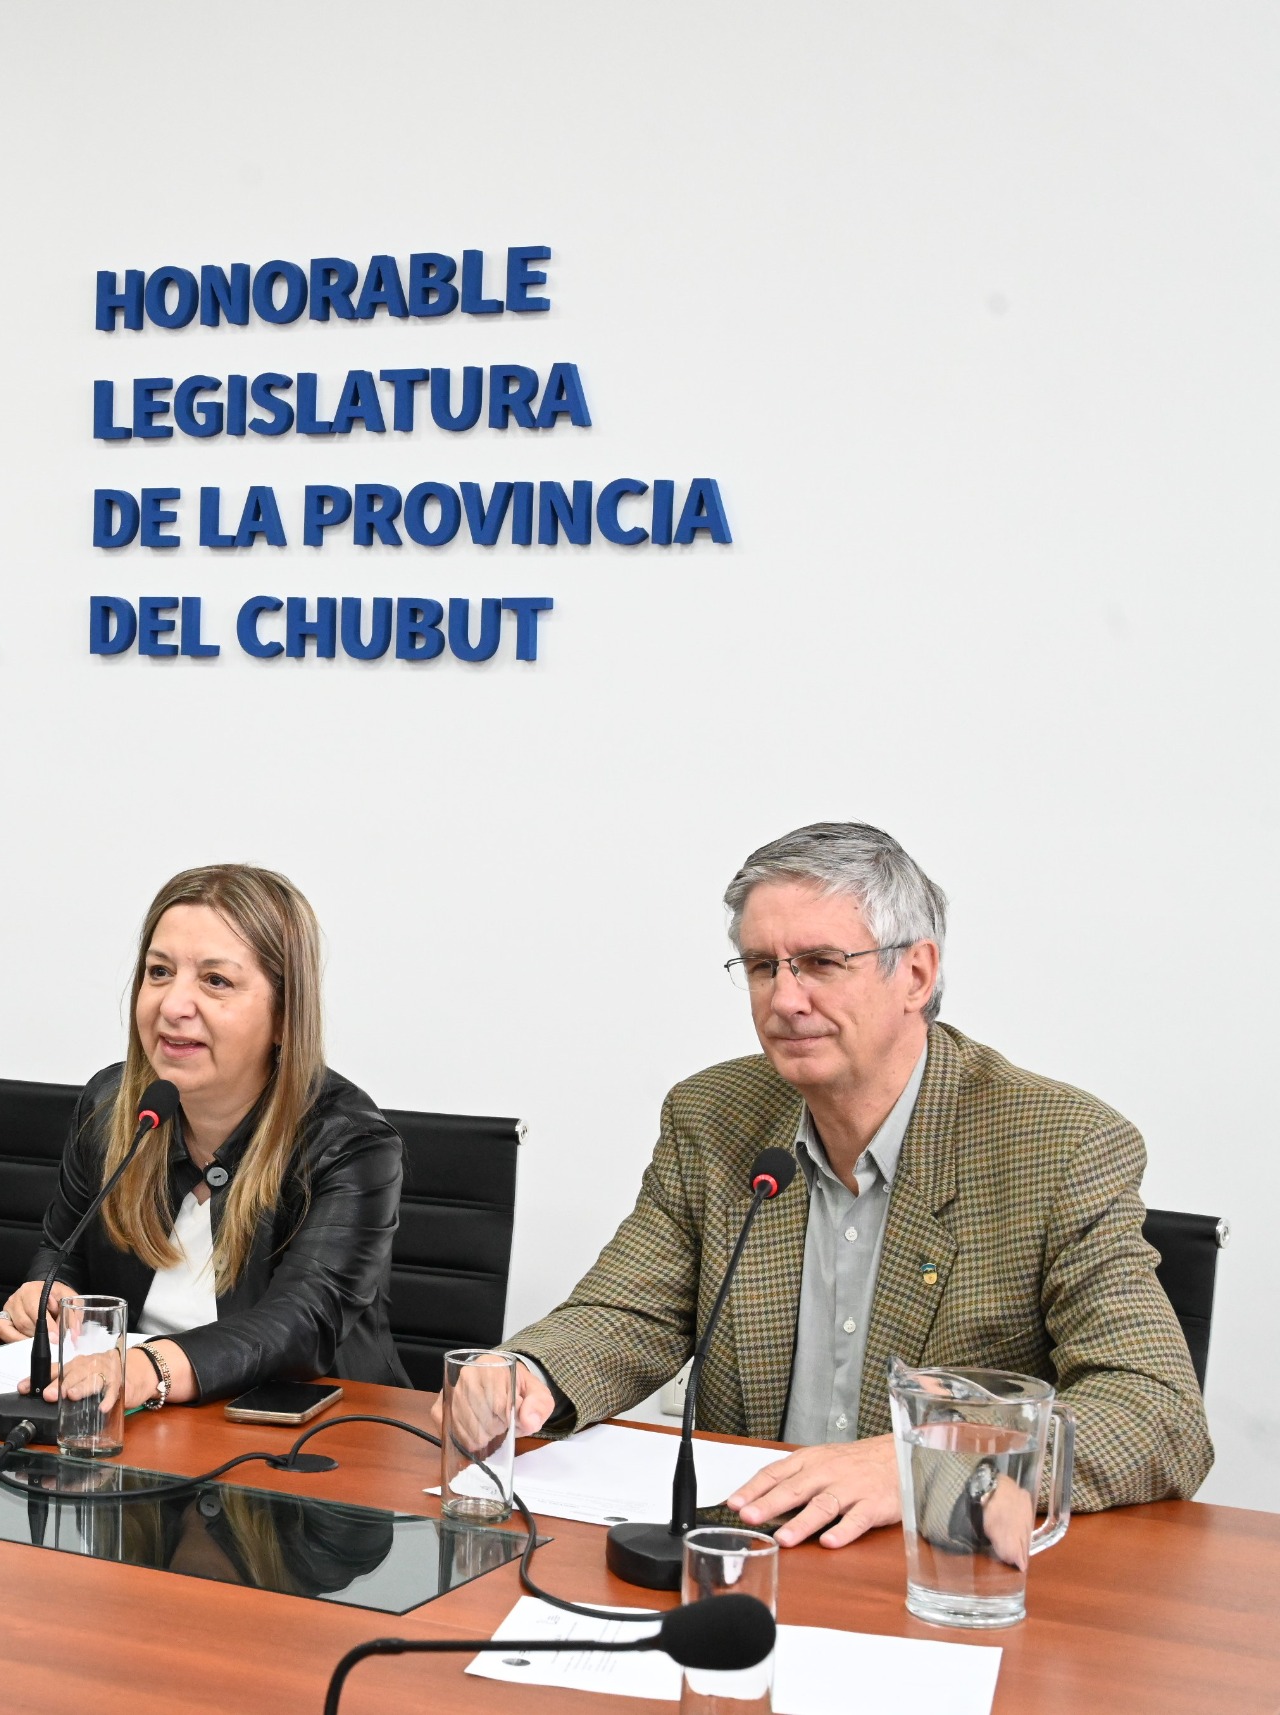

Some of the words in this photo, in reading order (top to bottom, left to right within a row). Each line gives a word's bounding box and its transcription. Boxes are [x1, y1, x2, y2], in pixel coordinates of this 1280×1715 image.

[95, 245, 552, 331] HONORABLE
[93, 362, 592, 440] LEGISLATURA
[93, 486, 181, 548] DE
[199, 485, 287, 548] LA
[303, 477, 734, 547] PROVINCIA
[89, 595, 220, 656] DEL
[236, 595, 554, 661] CHUBUT
